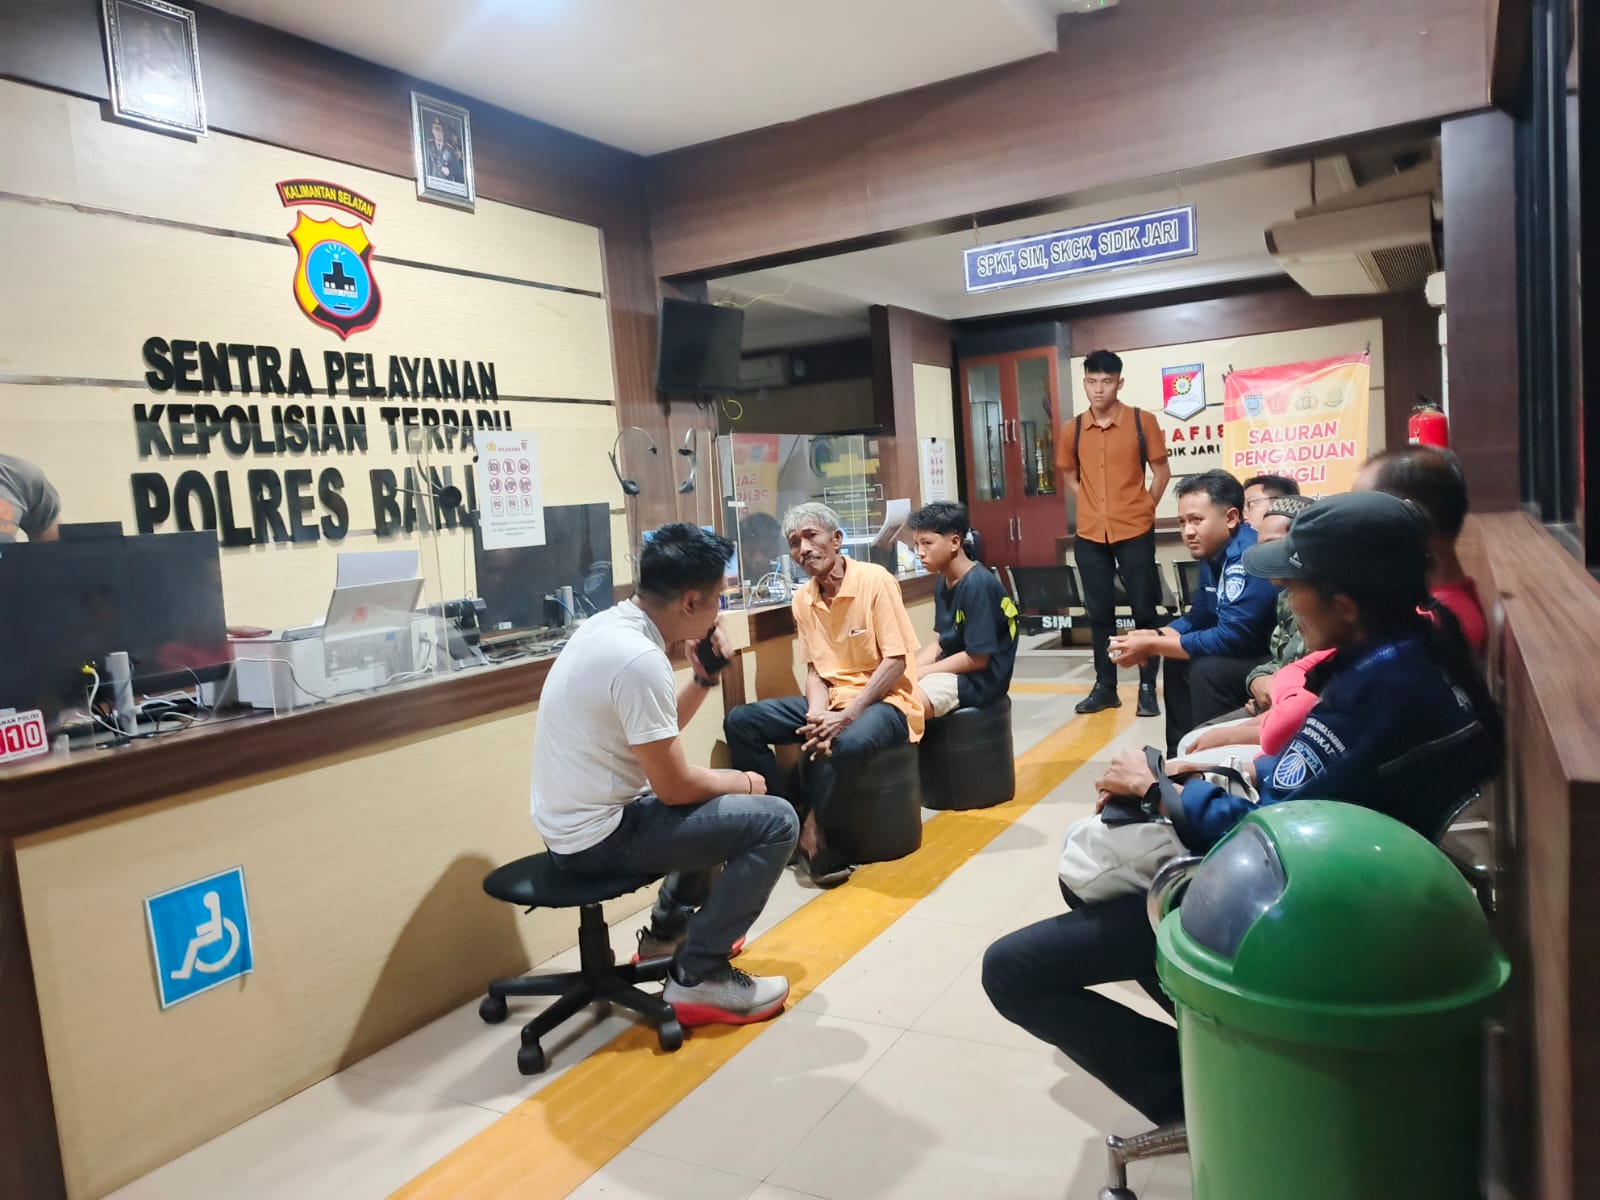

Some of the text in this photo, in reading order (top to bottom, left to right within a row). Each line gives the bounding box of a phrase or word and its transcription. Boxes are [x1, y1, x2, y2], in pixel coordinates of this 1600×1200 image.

[283, 184, 374, 217] KALIMANTAN SELATAN
[977, 219, 1179, 277] SPKT, SIM, SKCK, SIDIK JARI
[142, 337, 498, 400] SENTRA PELAYANAN
[133, 403, 370, 455] KEPOLISIAN
[1160, 424, 1224, 442] AFIS
[1249, 421, 1338, 444] SALURAN
[1190, 443, 1221, 456] JARI
[1234, 441, 1356, 467] PENGADUAN
[131, 467, 350, 547] POLRES
[1042, 615, 1073, 629] SIM
[1115, 618, 1136, 629] SIM
[1301, 726, 1337, 756] ADVOKAT
